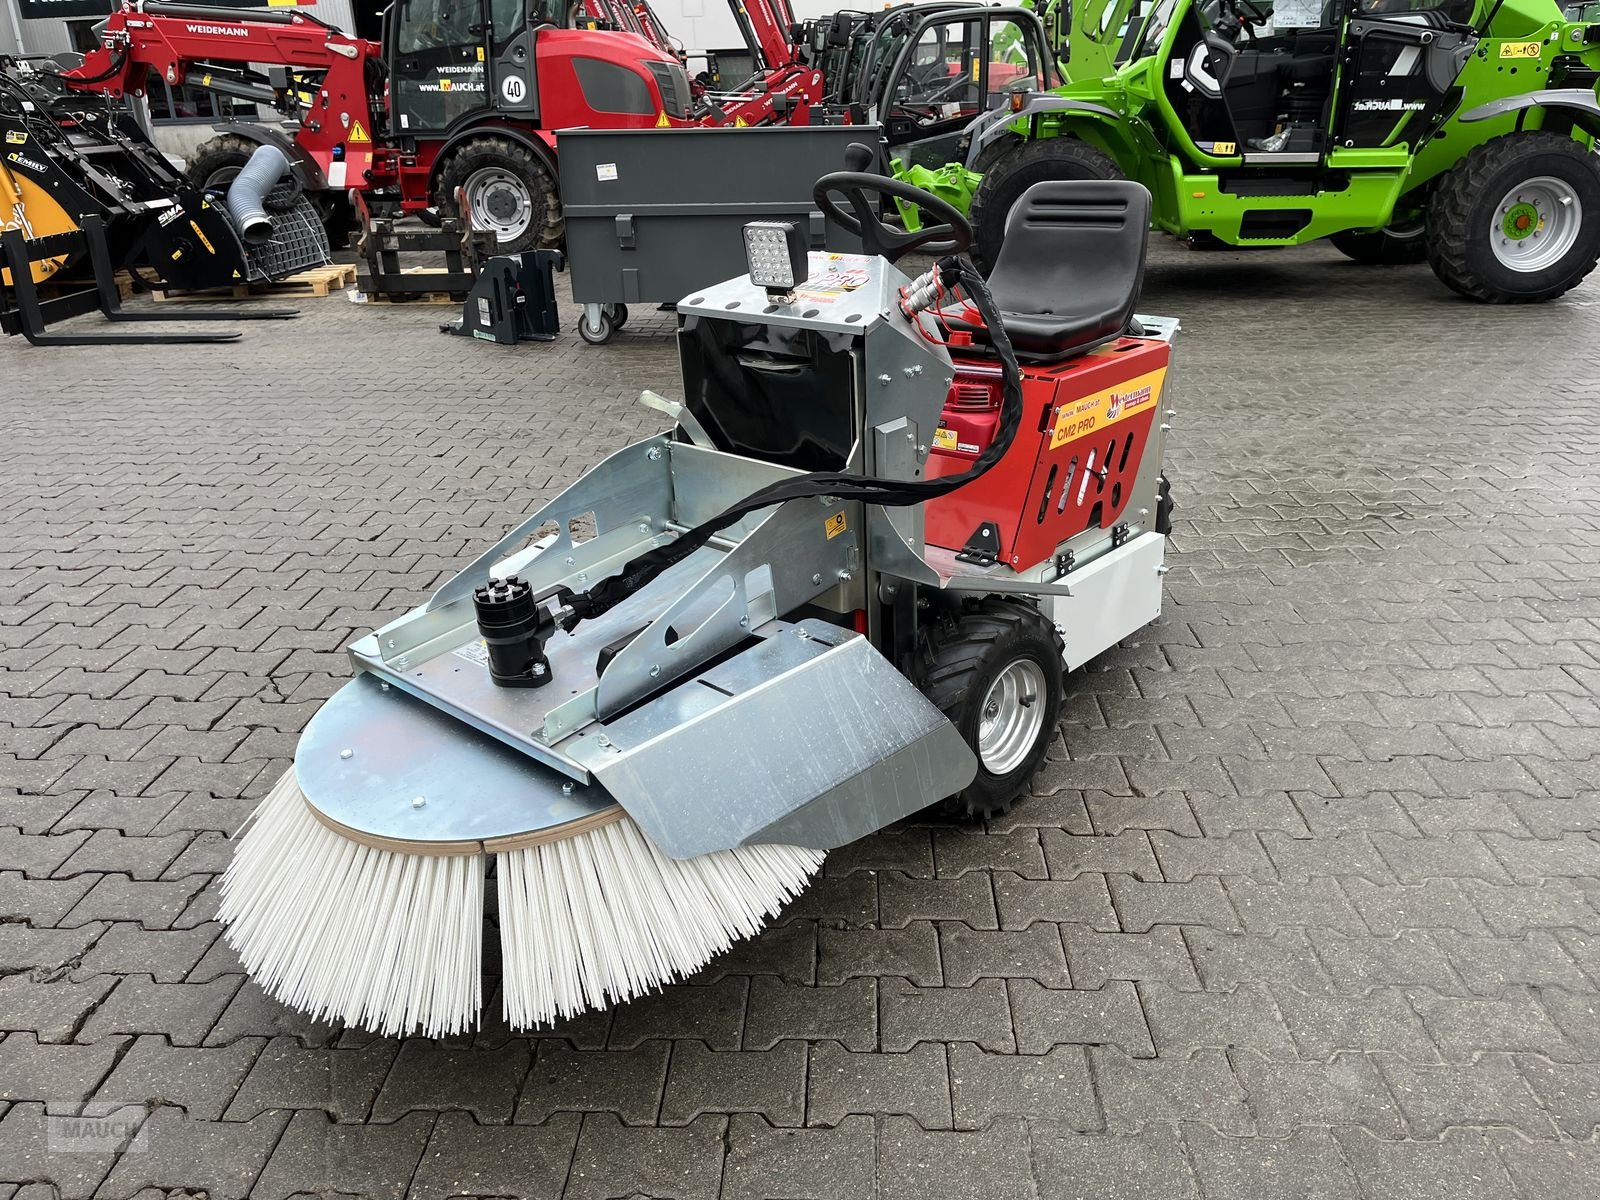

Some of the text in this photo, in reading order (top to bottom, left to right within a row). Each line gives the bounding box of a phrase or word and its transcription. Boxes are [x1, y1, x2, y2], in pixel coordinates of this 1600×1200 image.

[186, 24, 248, 37] WEIDEMANN
[436, 66, 484, 74] WEIDEMANN
[419, 82, 485, 92] www.MAUCH.at
[507, 81, 521, 98] 40
[158, 204, 183, 222] SIMA
[1057, 416, 1096, 441] CM2 PRO
